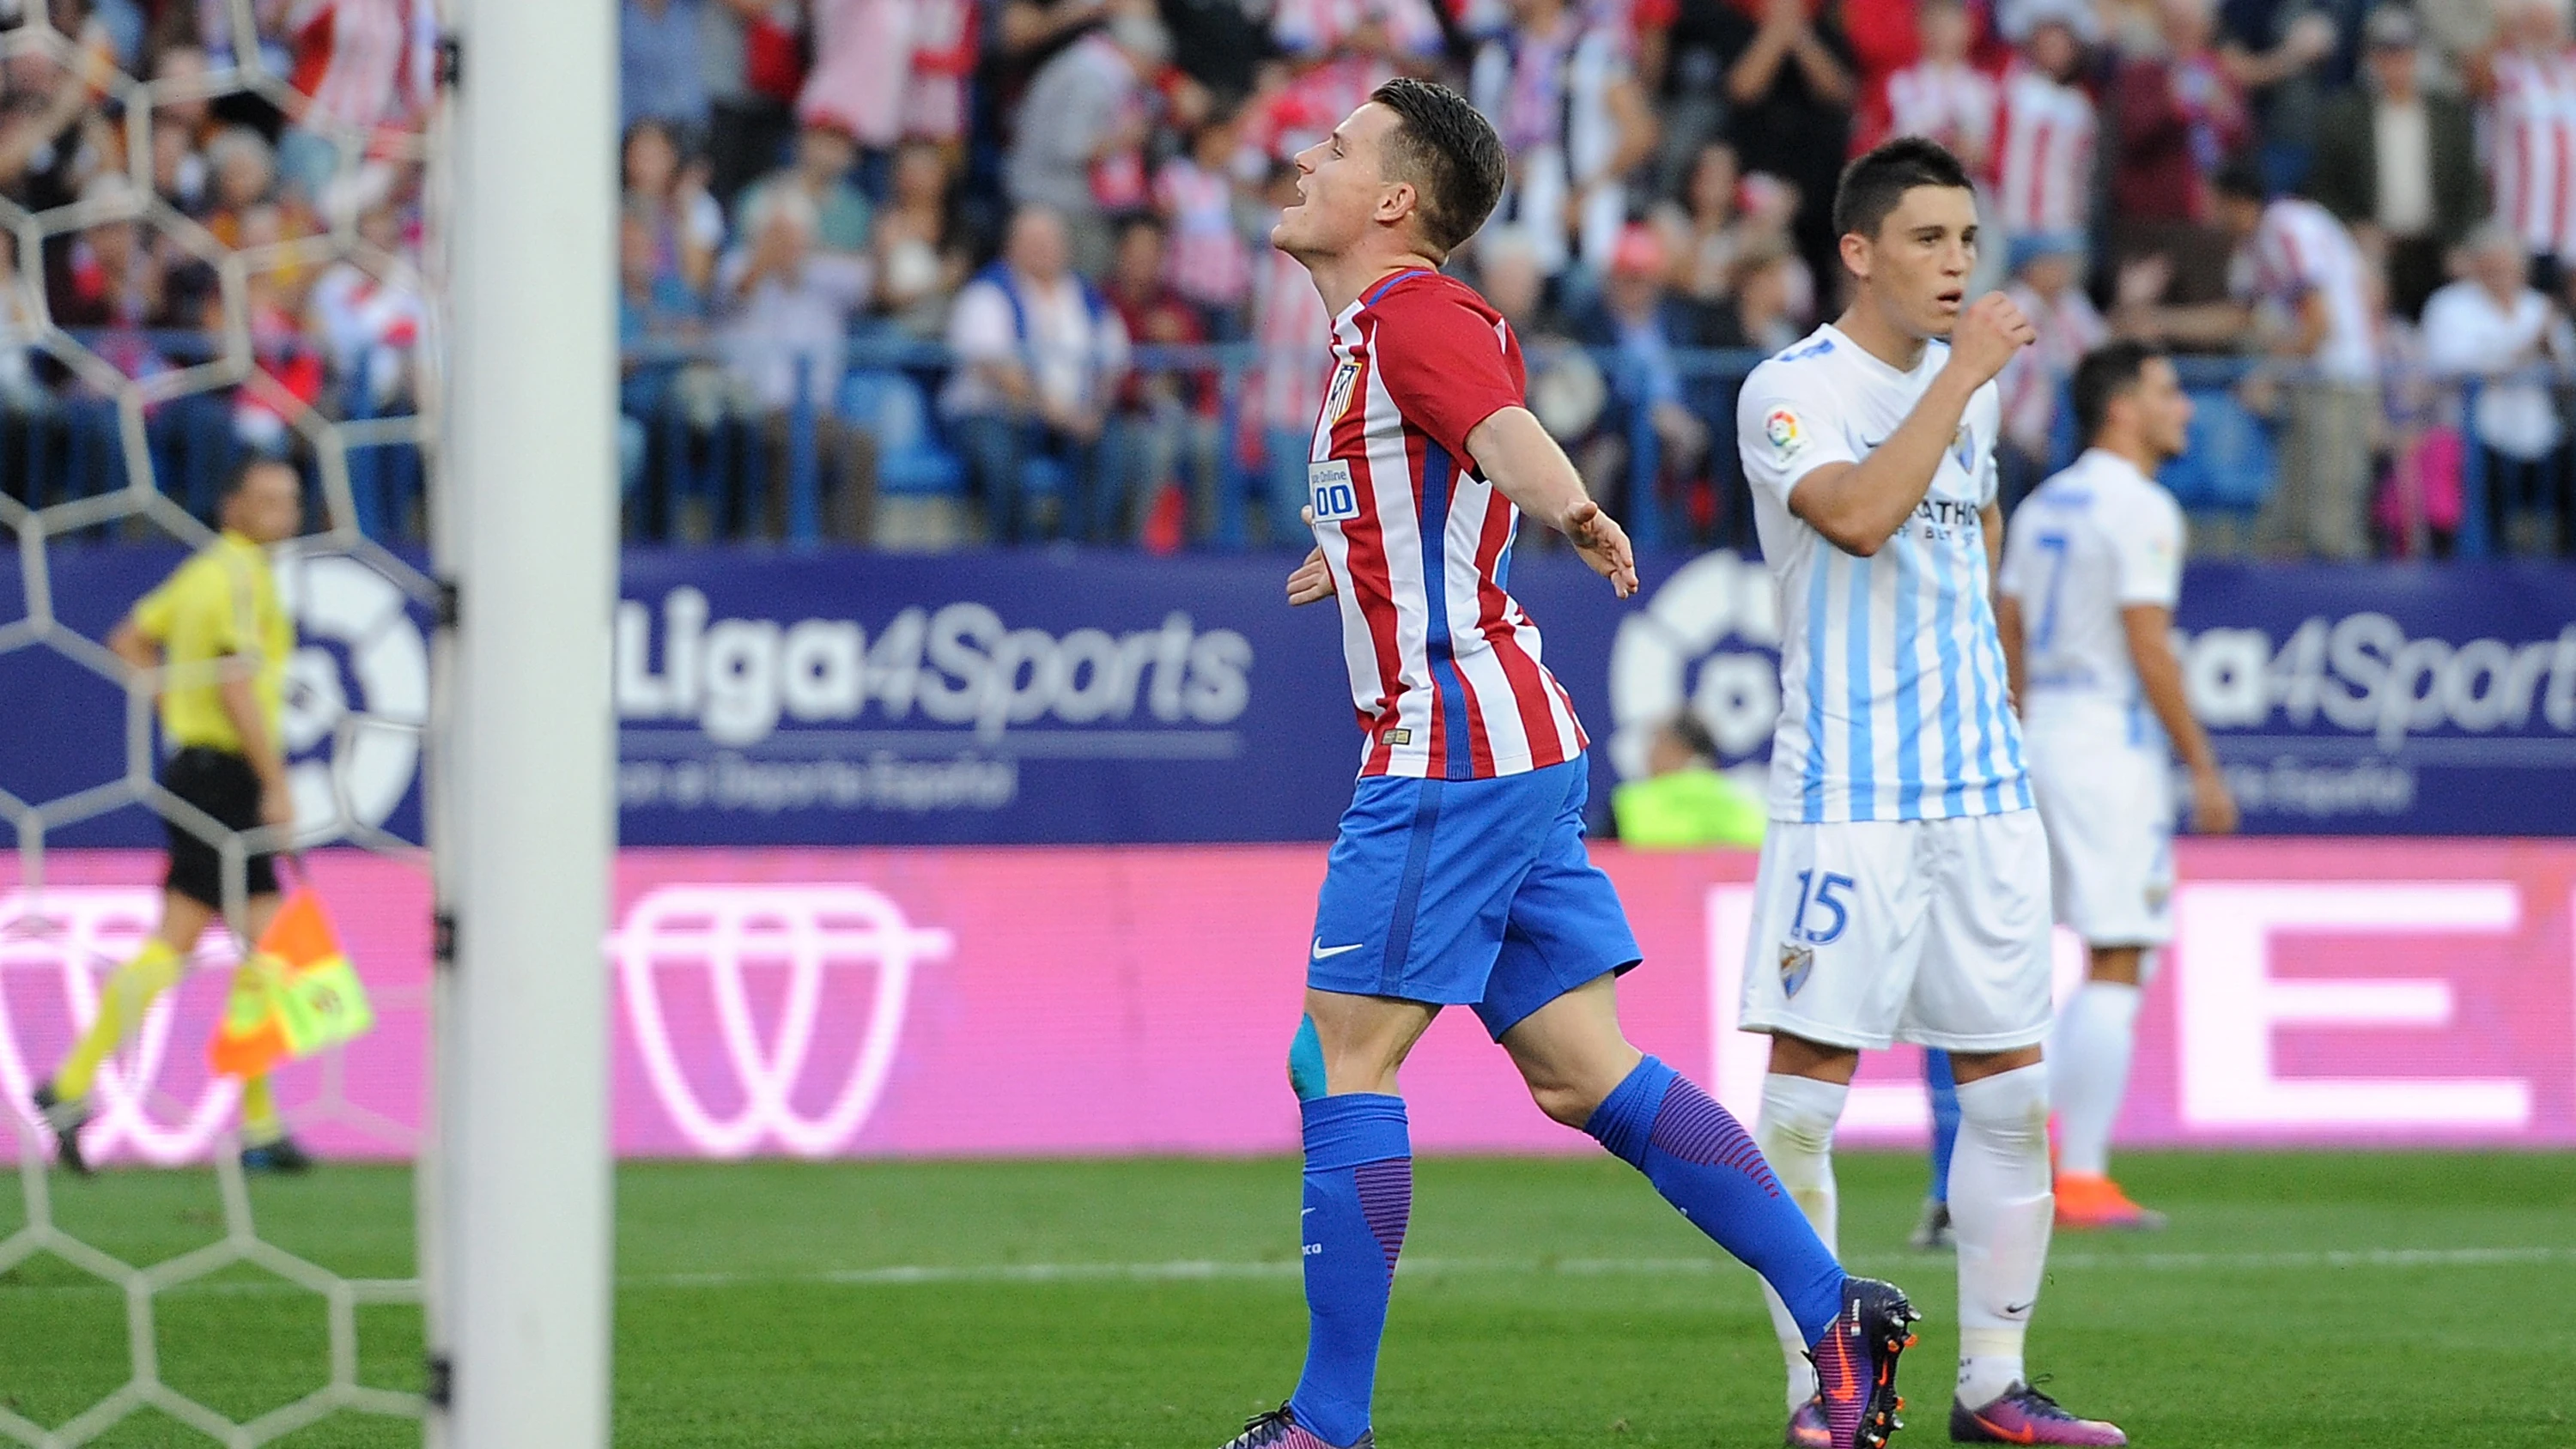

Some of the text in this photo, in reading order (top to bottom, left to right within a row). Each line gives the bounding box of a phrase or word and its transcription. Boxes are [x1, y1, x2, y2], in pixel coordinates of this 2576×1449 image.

[1313, 484, 1353, 517] 00
[2032, 529, 2071, 653] 7
[1791, 868, 1856, 945] 15
